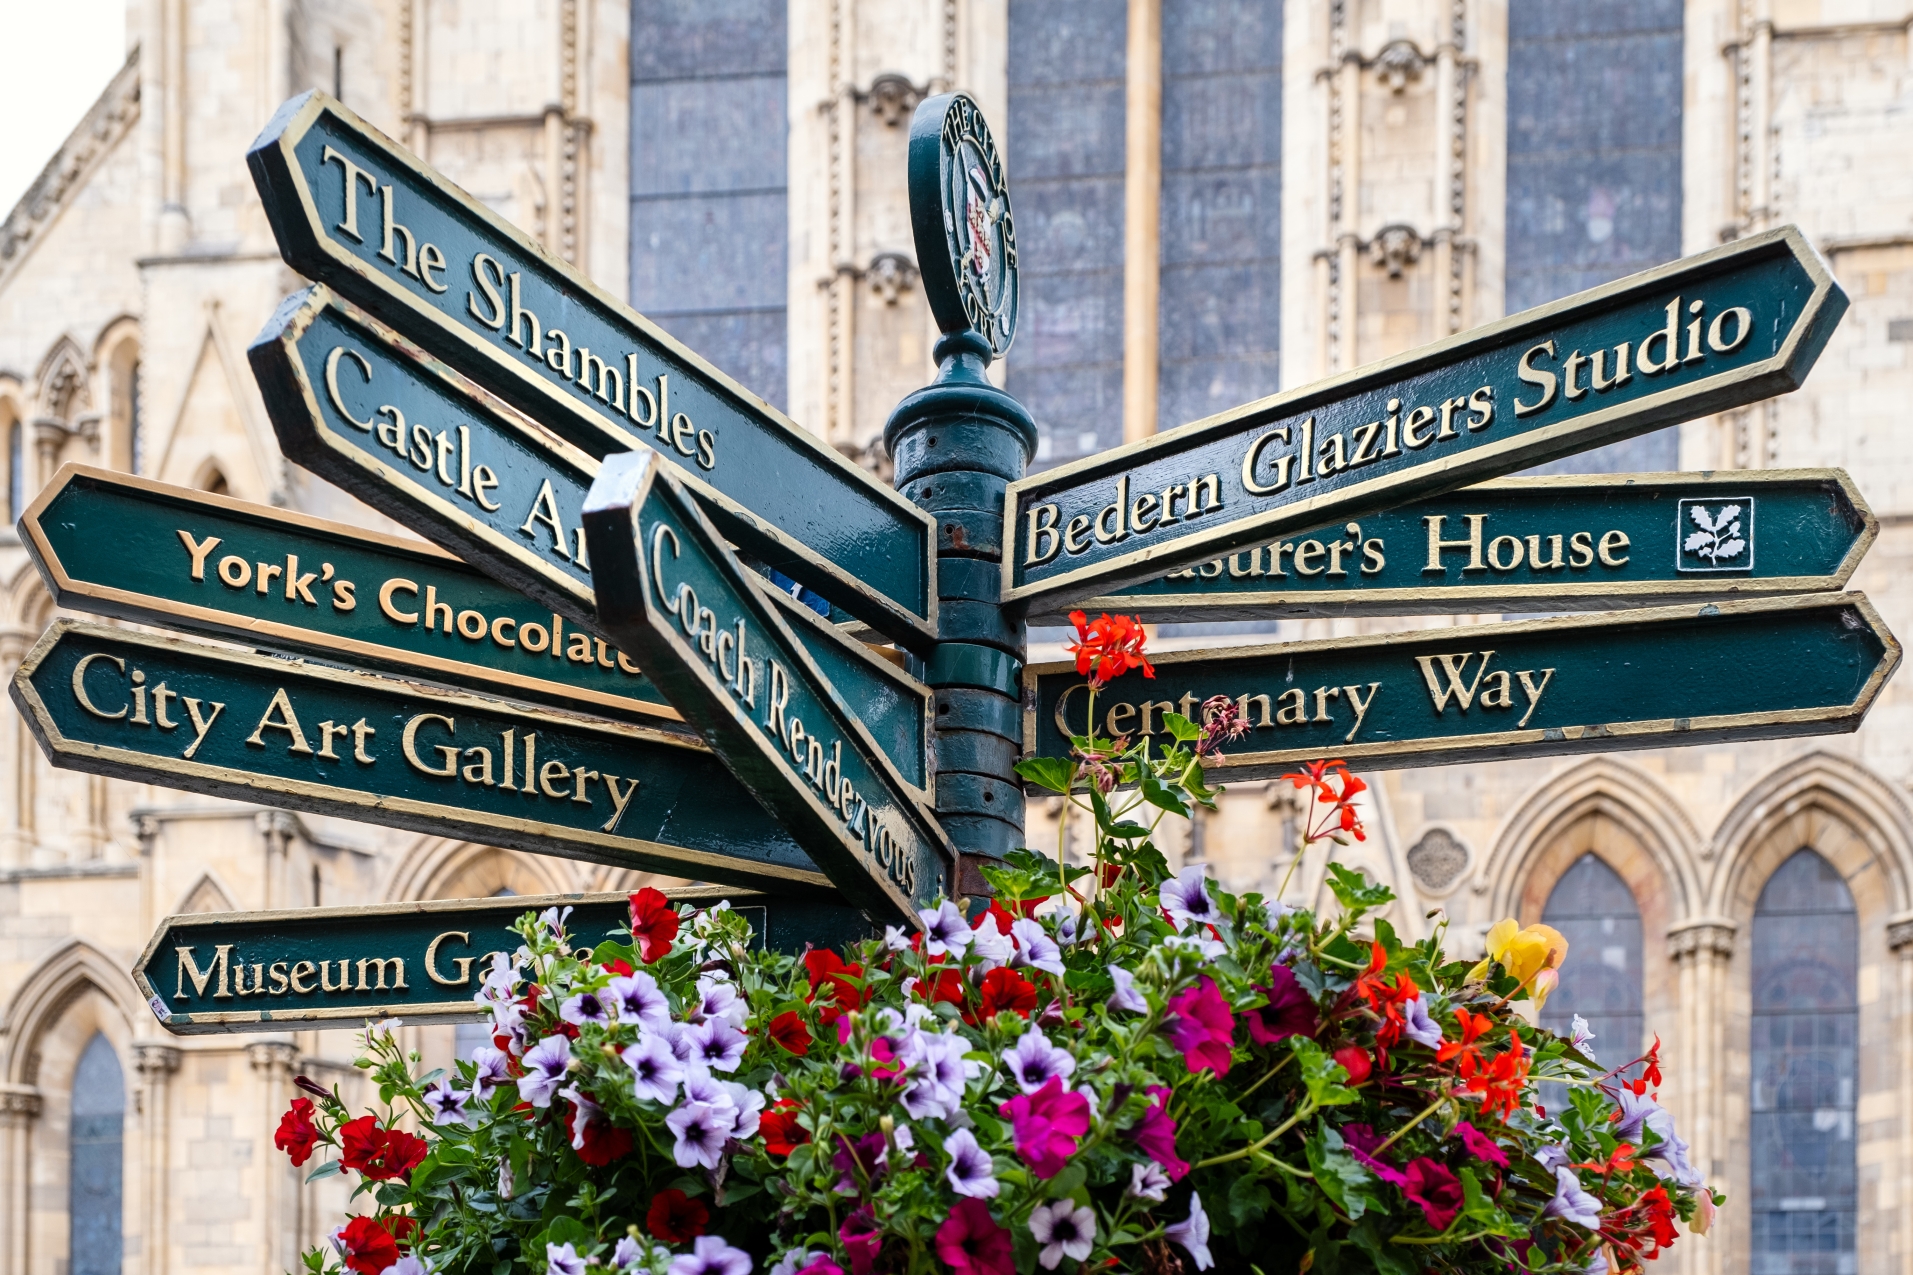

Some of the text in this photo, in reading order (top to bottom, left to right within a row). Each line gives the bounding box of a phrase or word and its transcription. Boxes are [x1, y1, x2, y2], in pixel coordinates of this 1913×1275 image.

[323, 144, 715, 470] The Shambles
[325, 346, 501, 511] Castle
[1024, 295, 1752, 567] Bedern Glaziers Studio
[176, 529, 356, 611] York's
[1422, 513, 1631, 573] House
[72, 653, 640, 834] City Art Gallery
[653, 523, 915, 897] Coach Rendezvous
[1415, 650, 1557, 729] Way
[173, 944, 410, 999] Museum
